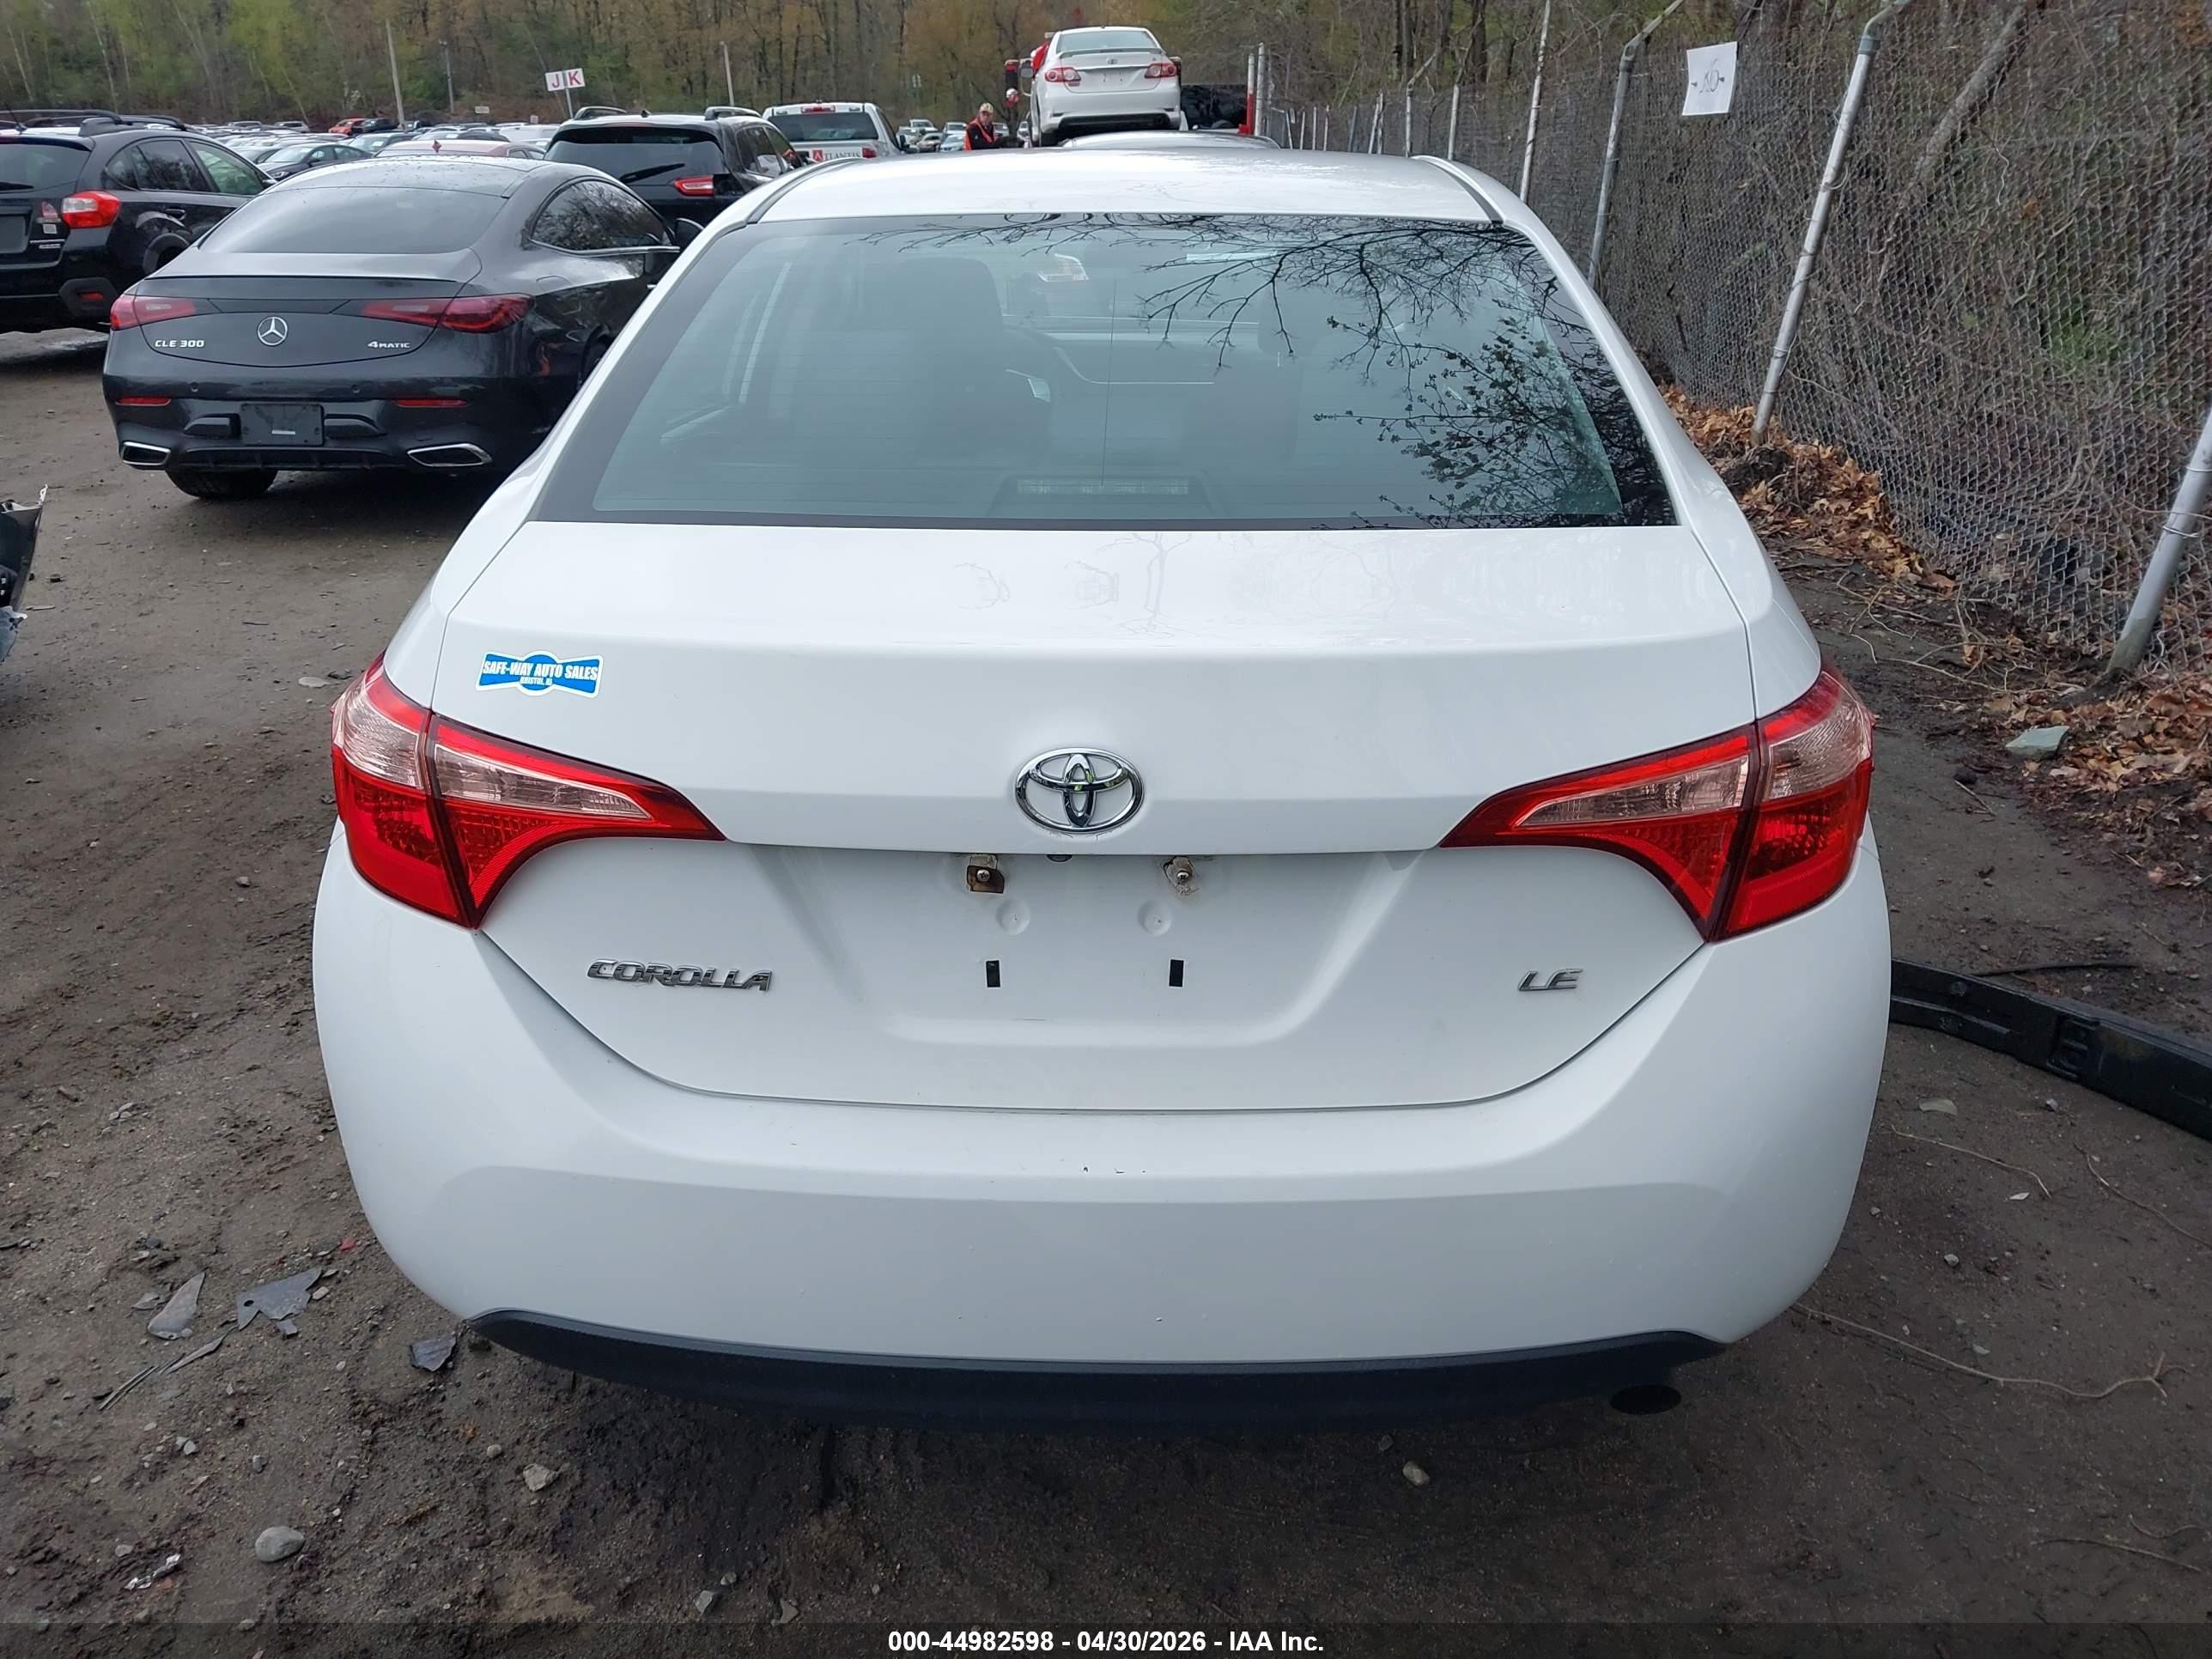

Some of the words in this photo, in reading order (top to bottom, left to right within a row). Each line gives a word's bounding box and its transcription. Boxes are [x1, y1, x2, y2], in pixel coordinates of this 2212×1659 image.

[551, 74, 560, 88] J
[568, 70, 582, 86] K
[155, 339, 177, 348] CLE
[179, 339, 204, 348] 300
[483, 660, 533, 677] SAFE-WAY
[534, 663, 562, 678] AUTO
[565, 665, 599, 681] SALES
[586, 958, 772, 993] COROLLA
[1517, 968, 1583, 992] LE
